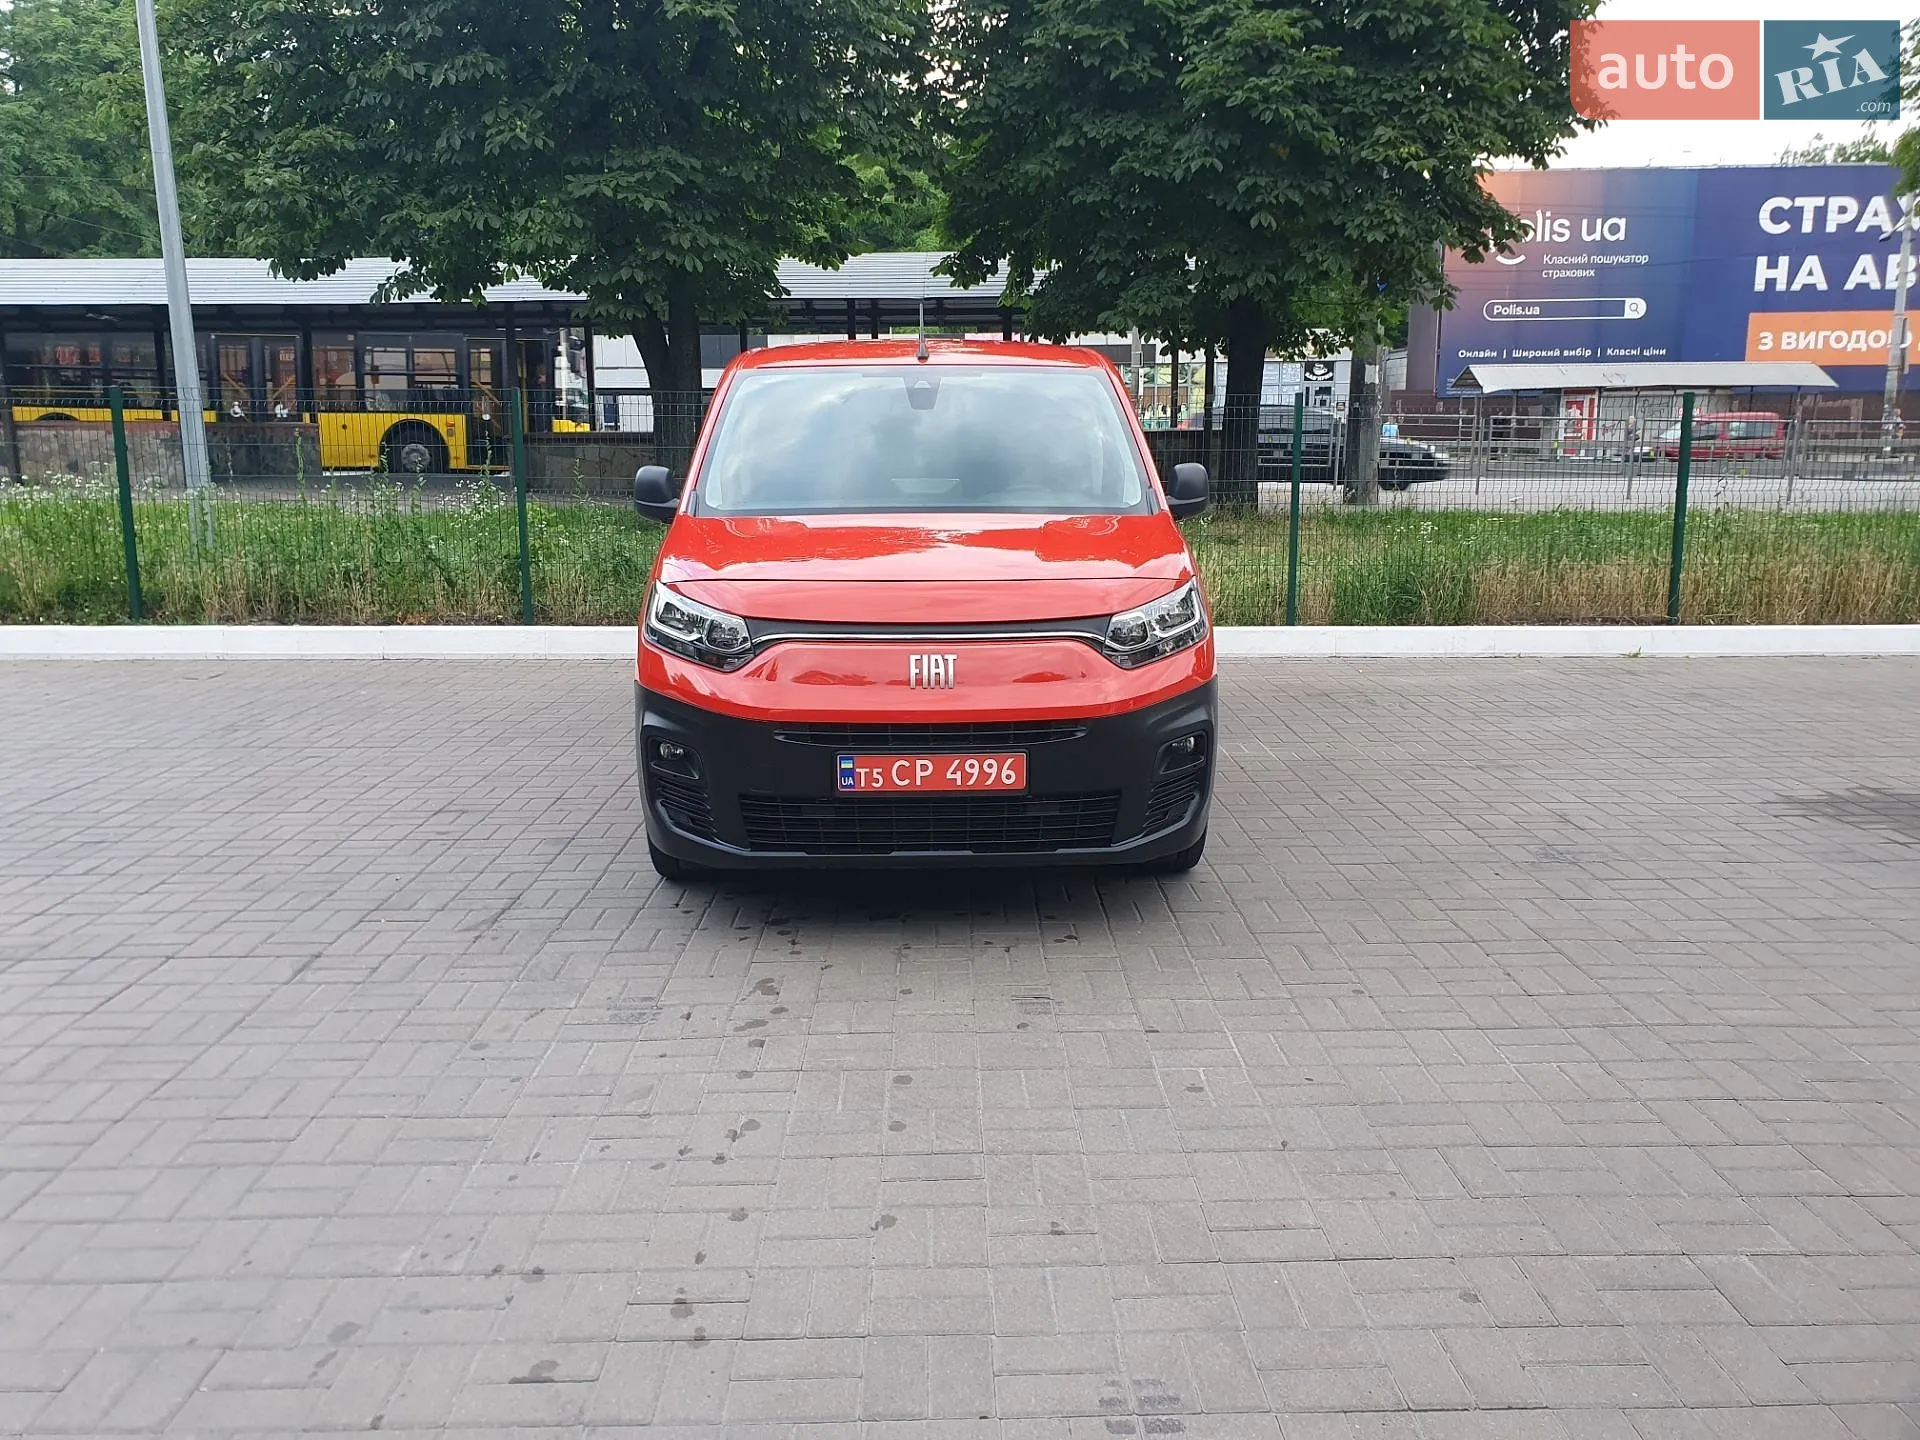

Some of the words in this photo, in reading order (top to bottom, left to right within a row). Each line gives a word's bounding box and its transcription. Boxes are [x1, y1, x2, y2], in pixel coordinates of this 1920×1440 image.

[1581, 217, 1627, 241] ua
[1543, 253, 1588, 265] Класний
[1590, 253, 1649, 266] пошукатор
[1542, 268, 1595, 279] страхових
[1754, 254, 1829, 292] НА
[1843, 253, 1920, 291] АВ
[1493, 304, 1540, 316] Polis.ua
[1458, 349, 1497, 358] Онлайн
[1512, 347, 1560, 359] Широкий
[1563, 347, 1592, 358] вибір
[1606, 346, 1640, 357] Класні
[1643, 346, 1666, 357] ціни
[909, 654, 957, 689] FIAT
[856, 768, 884, 788] T5
[891, 759, 934, 786] CP
[946, 757, 1016, 786] 4996
[841, 776, 854, 786] UA
